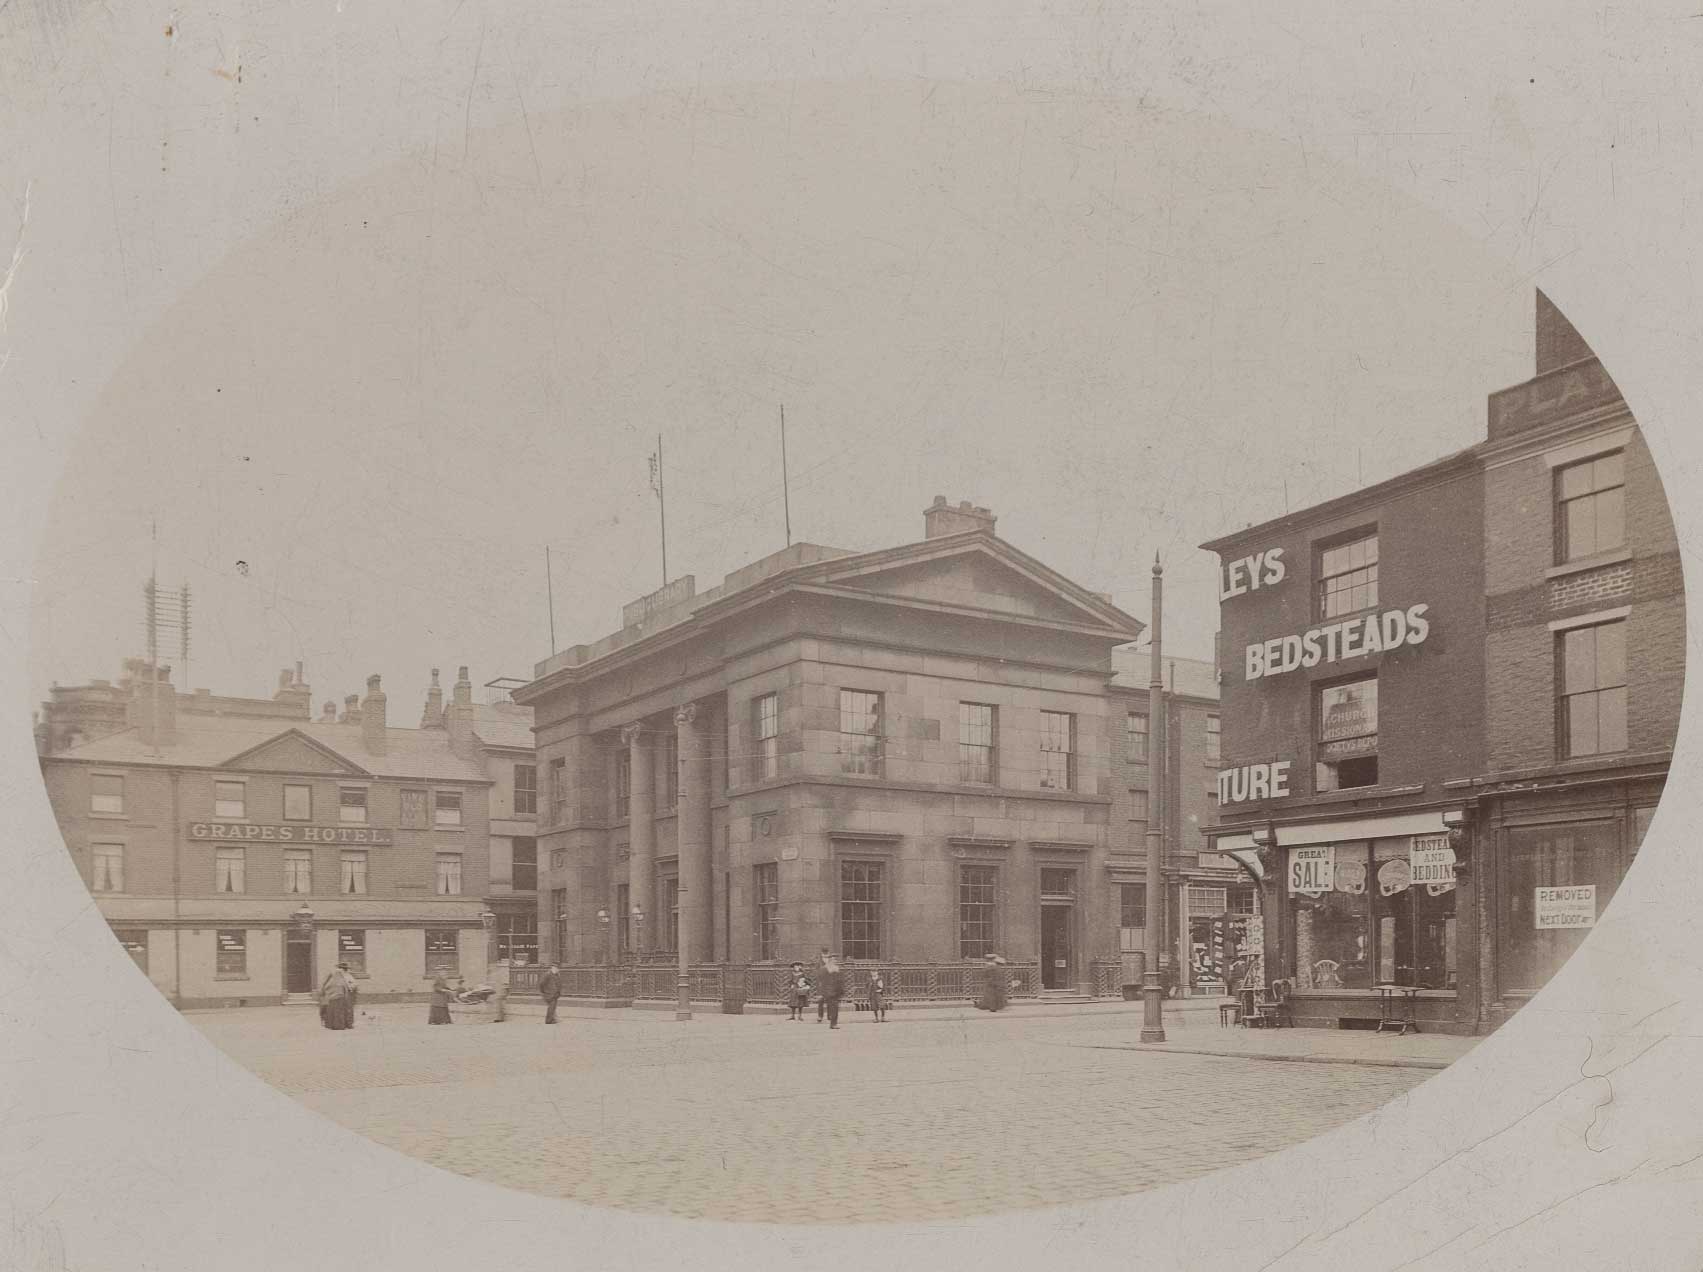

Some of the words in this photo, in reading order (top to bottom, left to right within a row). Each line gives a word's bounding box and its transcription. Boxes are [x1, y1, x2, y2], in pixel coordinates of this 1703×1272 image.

[1220, 548, 1285, 602] LEYS
[1245, 603, 1430, 681] BEDSTEADS
[191, 823, 294, 840] GRAPES
[303, 827, 392, 843] HOTEL.
[1297, 849, 1326, 859] GREAT
[1423, 852, 1445, 863] AND
[1293, 861, 1329, 889] SALE
[1540, 888, 1591, 902] REMOVED
